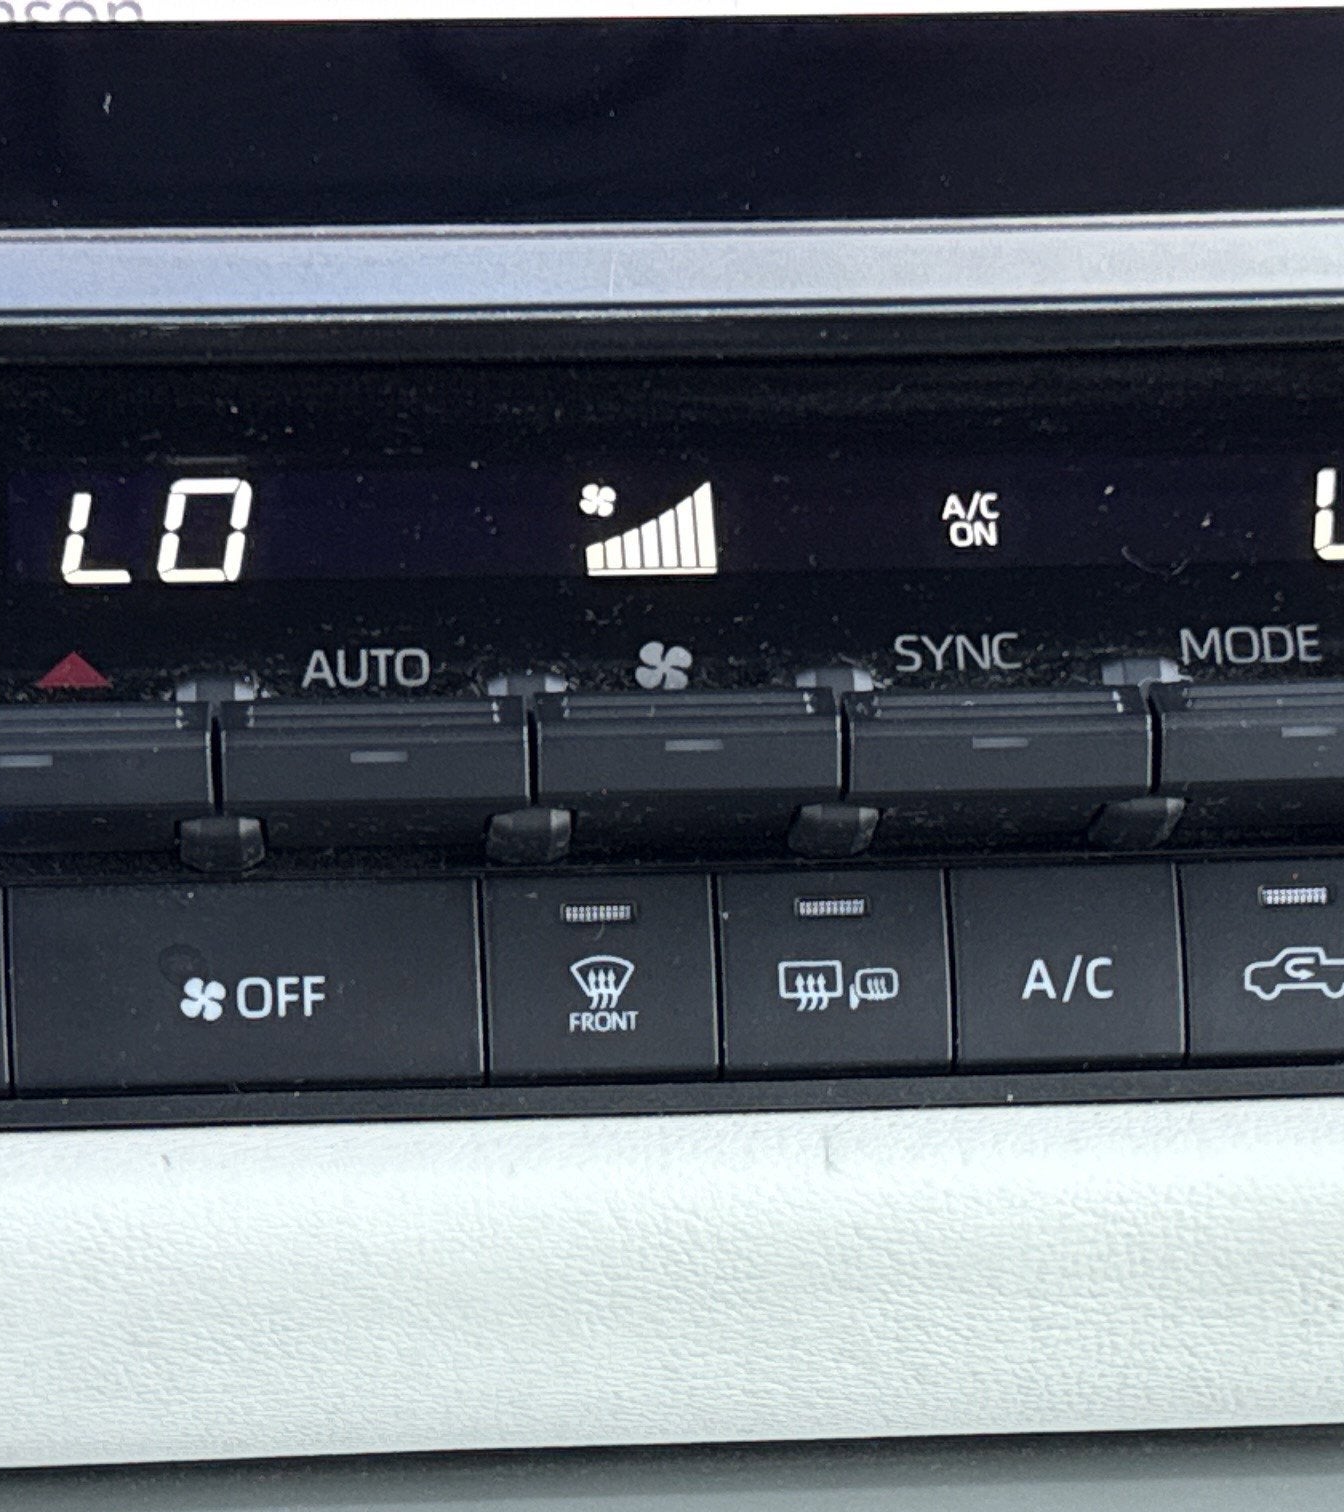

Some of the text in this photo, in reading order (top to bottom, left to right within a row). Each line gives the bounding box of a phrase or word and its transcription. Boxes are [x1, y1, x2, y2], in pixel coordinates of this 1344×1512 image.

[942, 491, 1000, 522] A/C
[949, 522, 998, 548] ON
[894, 633, 1022, 672] SYNC
[1179, 624, 1322, 666] MODE
[302, 648, 430, 689] AUTO
[236, 975, 326, 1019] OFF
[1021, 954, 1115, 1003] A/C
[569, 1011, 639, 1032] FRONT
